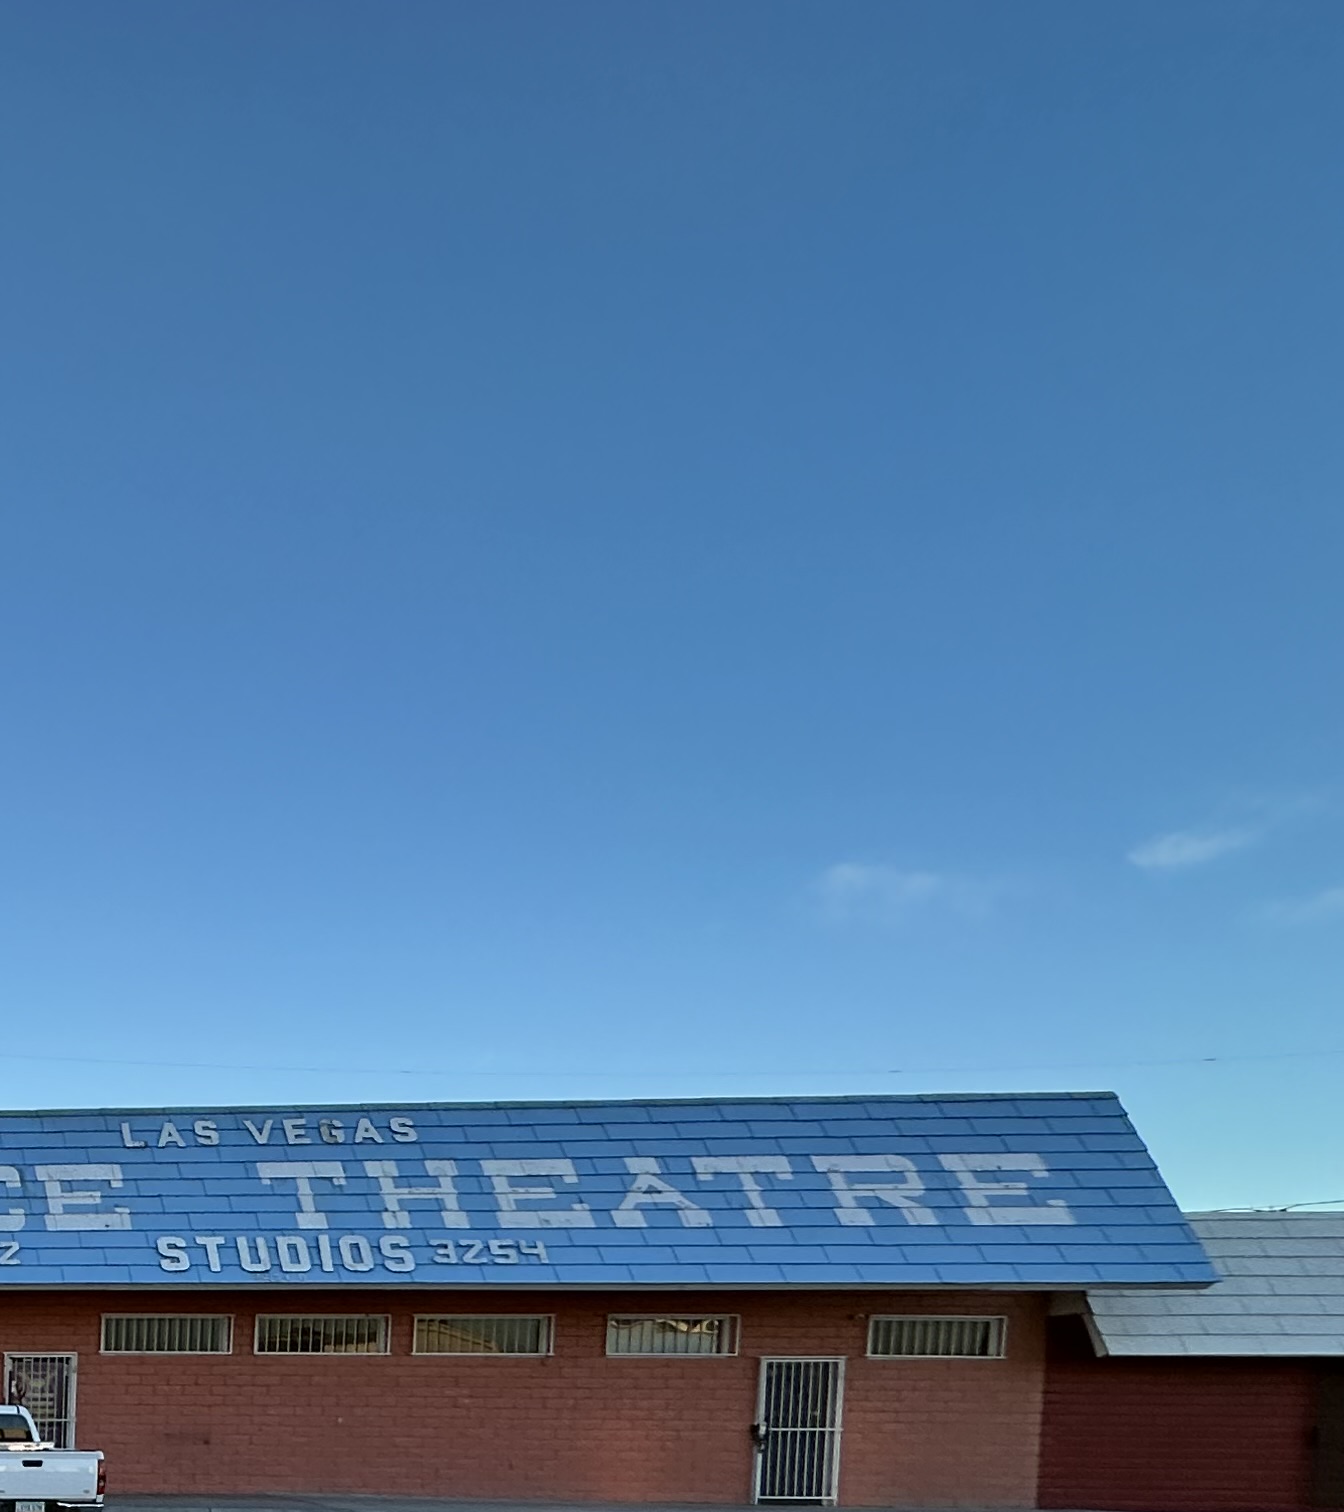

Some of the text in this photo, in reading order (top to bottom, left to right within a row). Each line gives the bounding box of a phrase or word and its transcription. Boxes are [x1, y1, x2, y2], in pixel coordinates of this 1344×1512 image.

[120, 1117, 418, 1147] LAS VEGAS
[256, 1153, 1077, 1229] THEATRE
[156, 1234, 416, 1272] STUDIOS
[430, 1239, 549, 1264] 3254
